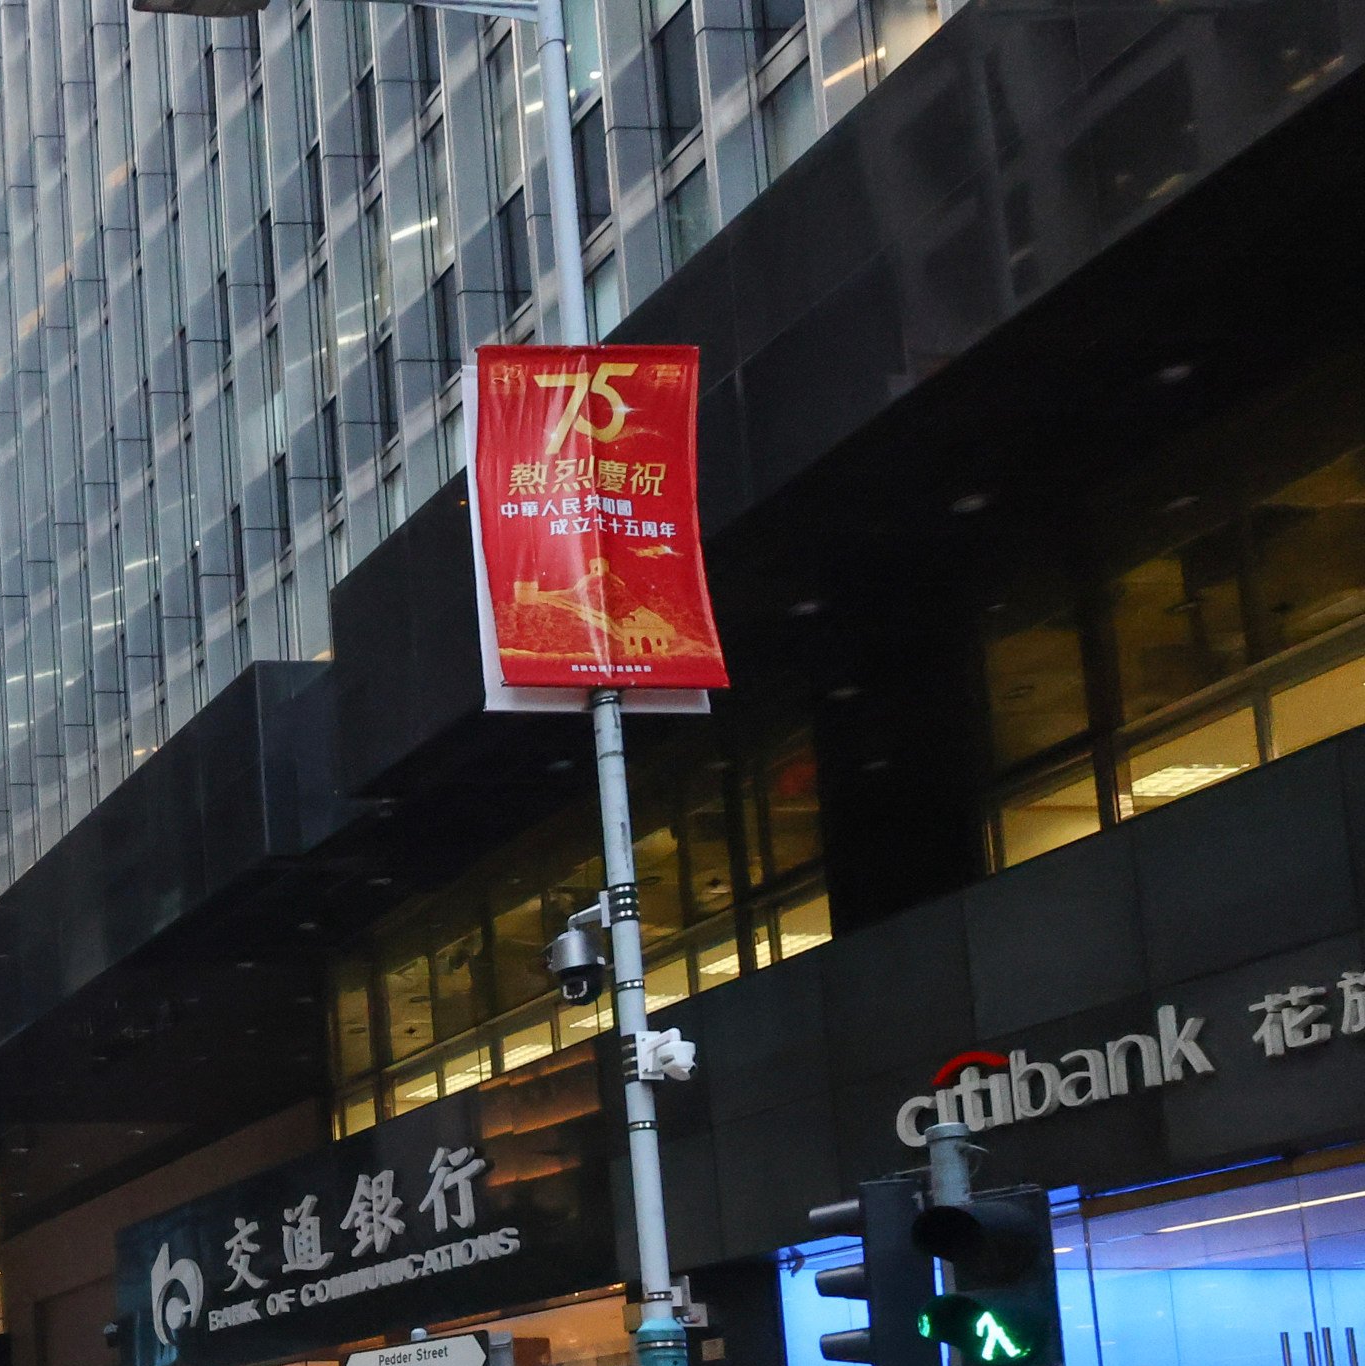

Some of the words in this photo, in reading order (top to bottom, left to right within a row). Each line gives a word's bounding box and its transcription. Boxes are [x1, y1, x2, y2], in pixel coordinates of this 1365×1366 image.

[533, 363, 639, 455] 75
[500, 494, 633, 519] 中華人民共和國
[508, 455, 667, 497] 熱烈慶祝
[550, 515, 677, 539] 成立七十五周年
[895, 1003, 1216, 1148] citibank
[223, 1146, 487, 1292] 交通銀行
[207, 1299, 261, 1331] BANK
[266, 1288, 296, 1317] OF
[300, 1226, 521, 1307] COMMUNICATIONS
[378, 1351, 413, 1366] Pedder
[416, 1345, 449, 1361] Street
